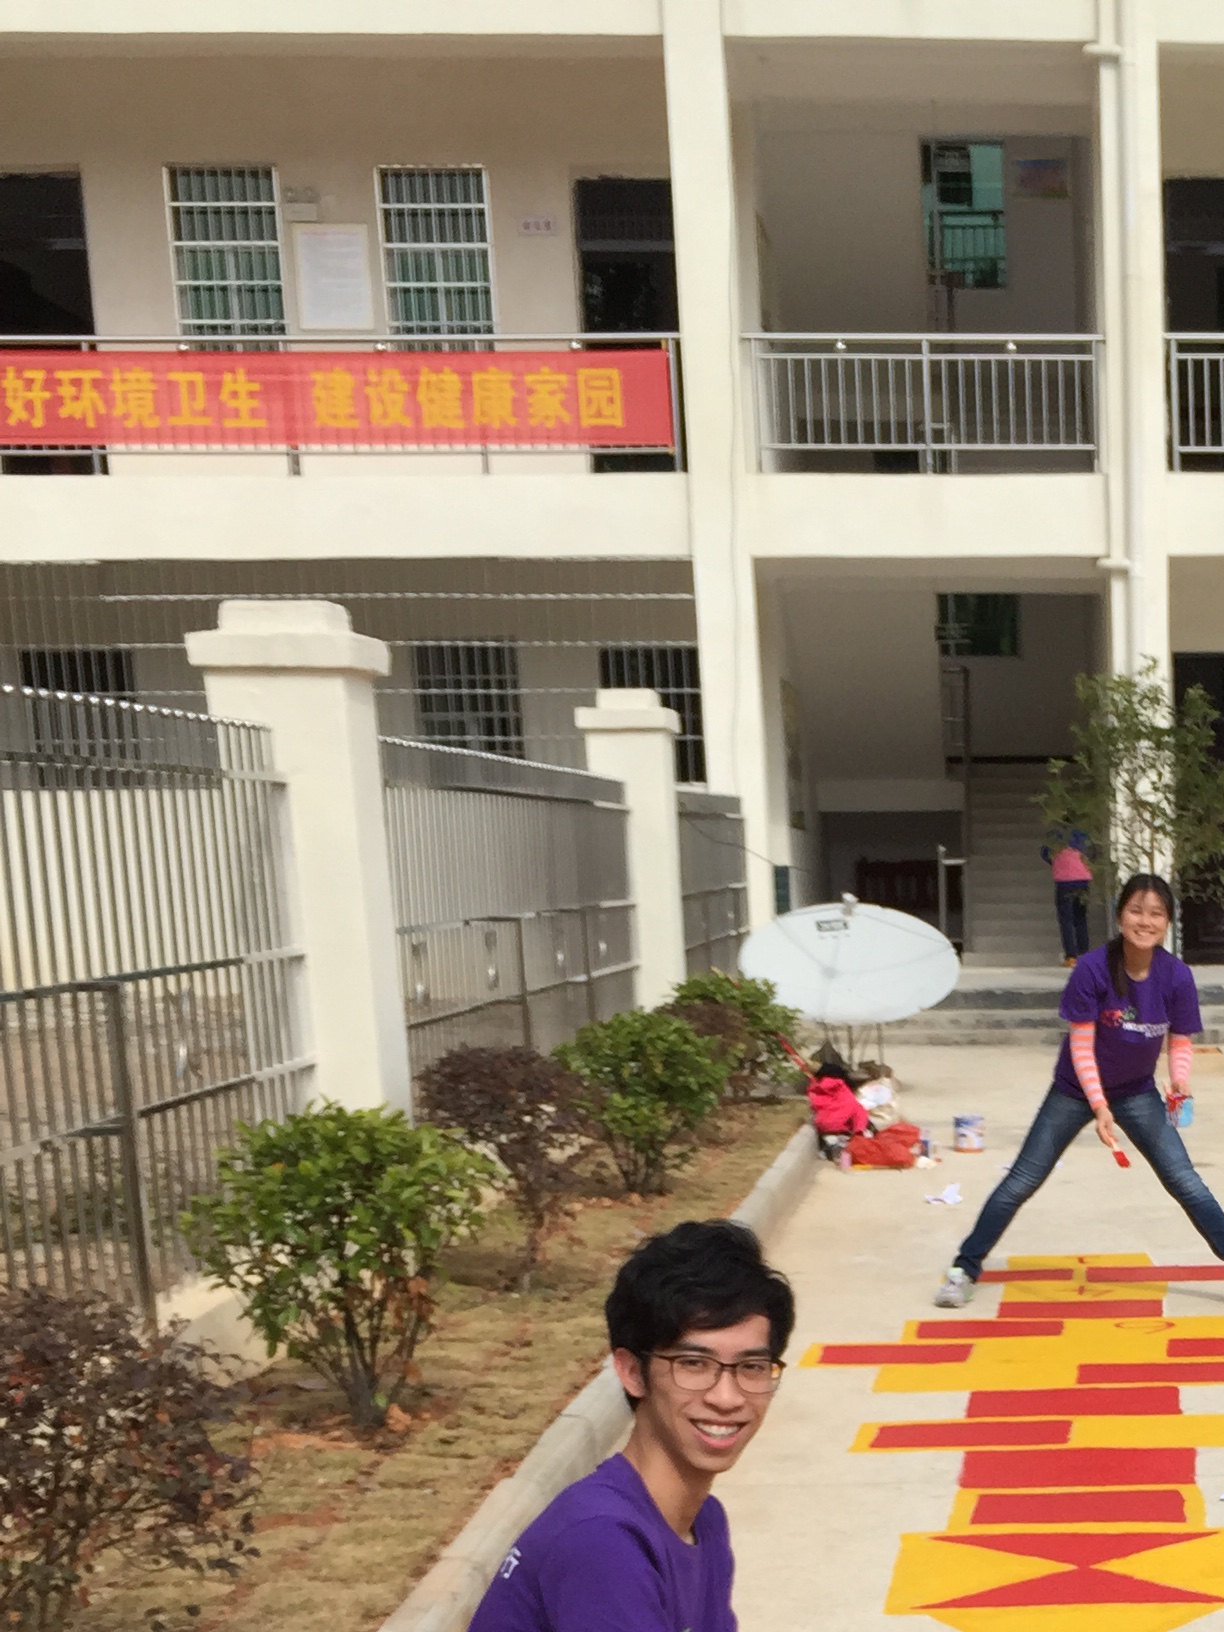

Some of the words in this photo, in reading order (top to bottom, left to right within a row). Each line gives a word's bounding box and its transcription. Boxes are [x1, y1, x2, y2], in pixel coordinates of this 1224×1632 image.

[2, 366, 266, 428] 好环境卫生
[310, 366, 624, 429] 建设健康家园
